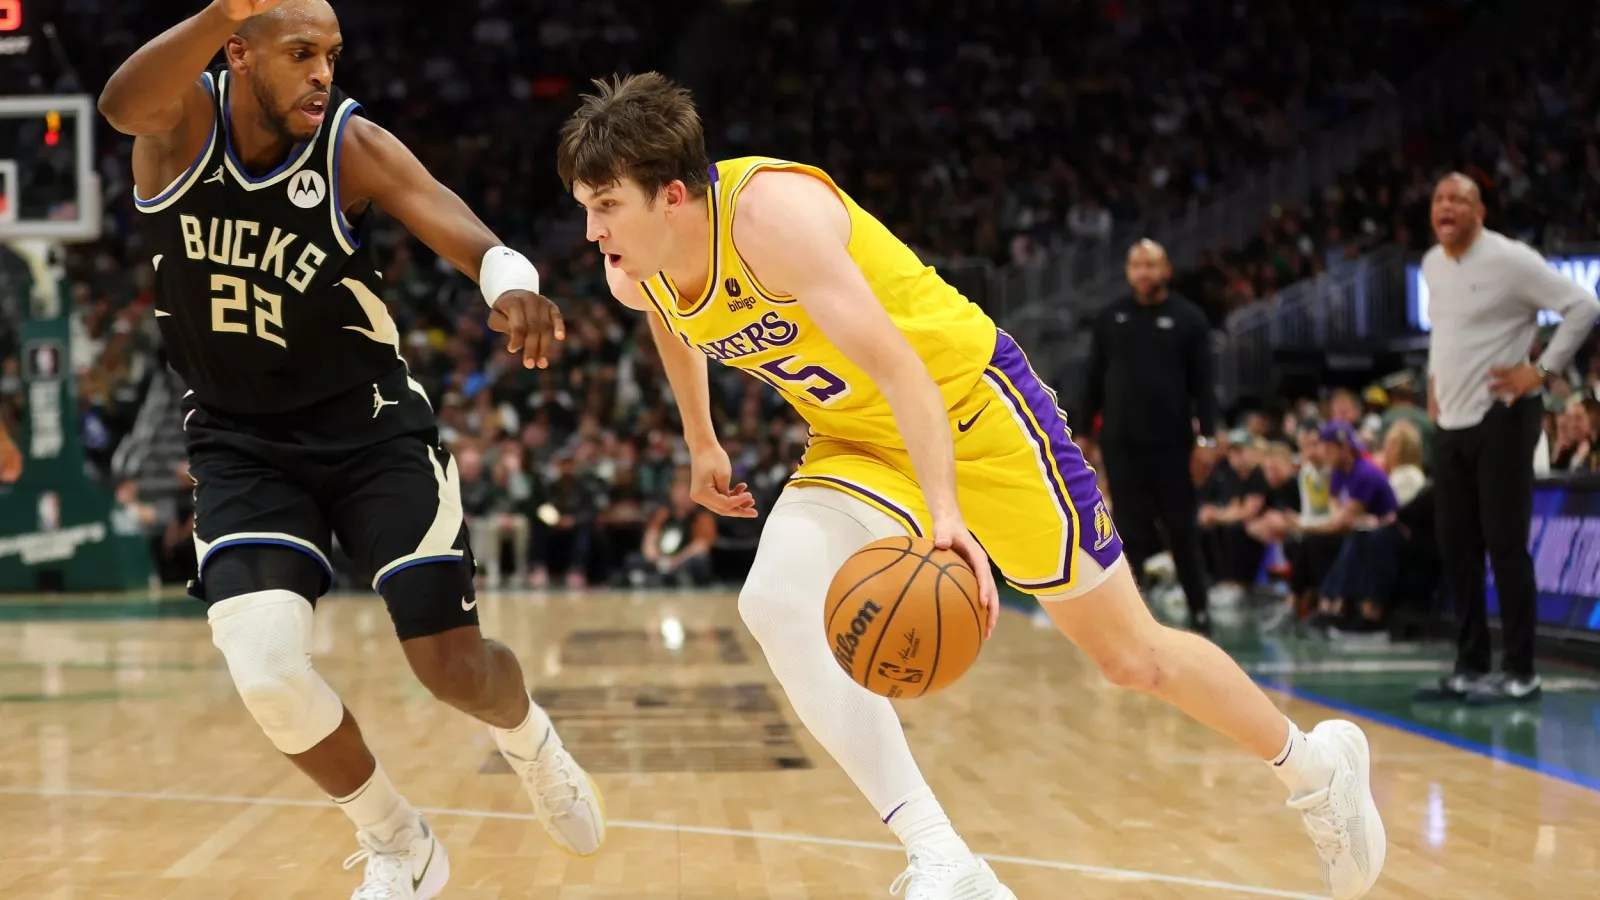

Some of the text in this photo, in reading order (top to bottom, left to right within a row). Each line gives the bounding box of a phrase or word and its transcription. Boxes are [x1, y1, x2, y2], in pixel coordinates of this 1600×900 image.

[179, 213, 328, 293] BUCKS
[210, 274, 287, 348] 22
[679, 310, 800, 362] AKERS
[727, 296, 756, 312] bibigo
[834, 598, 882, 680] ilson
